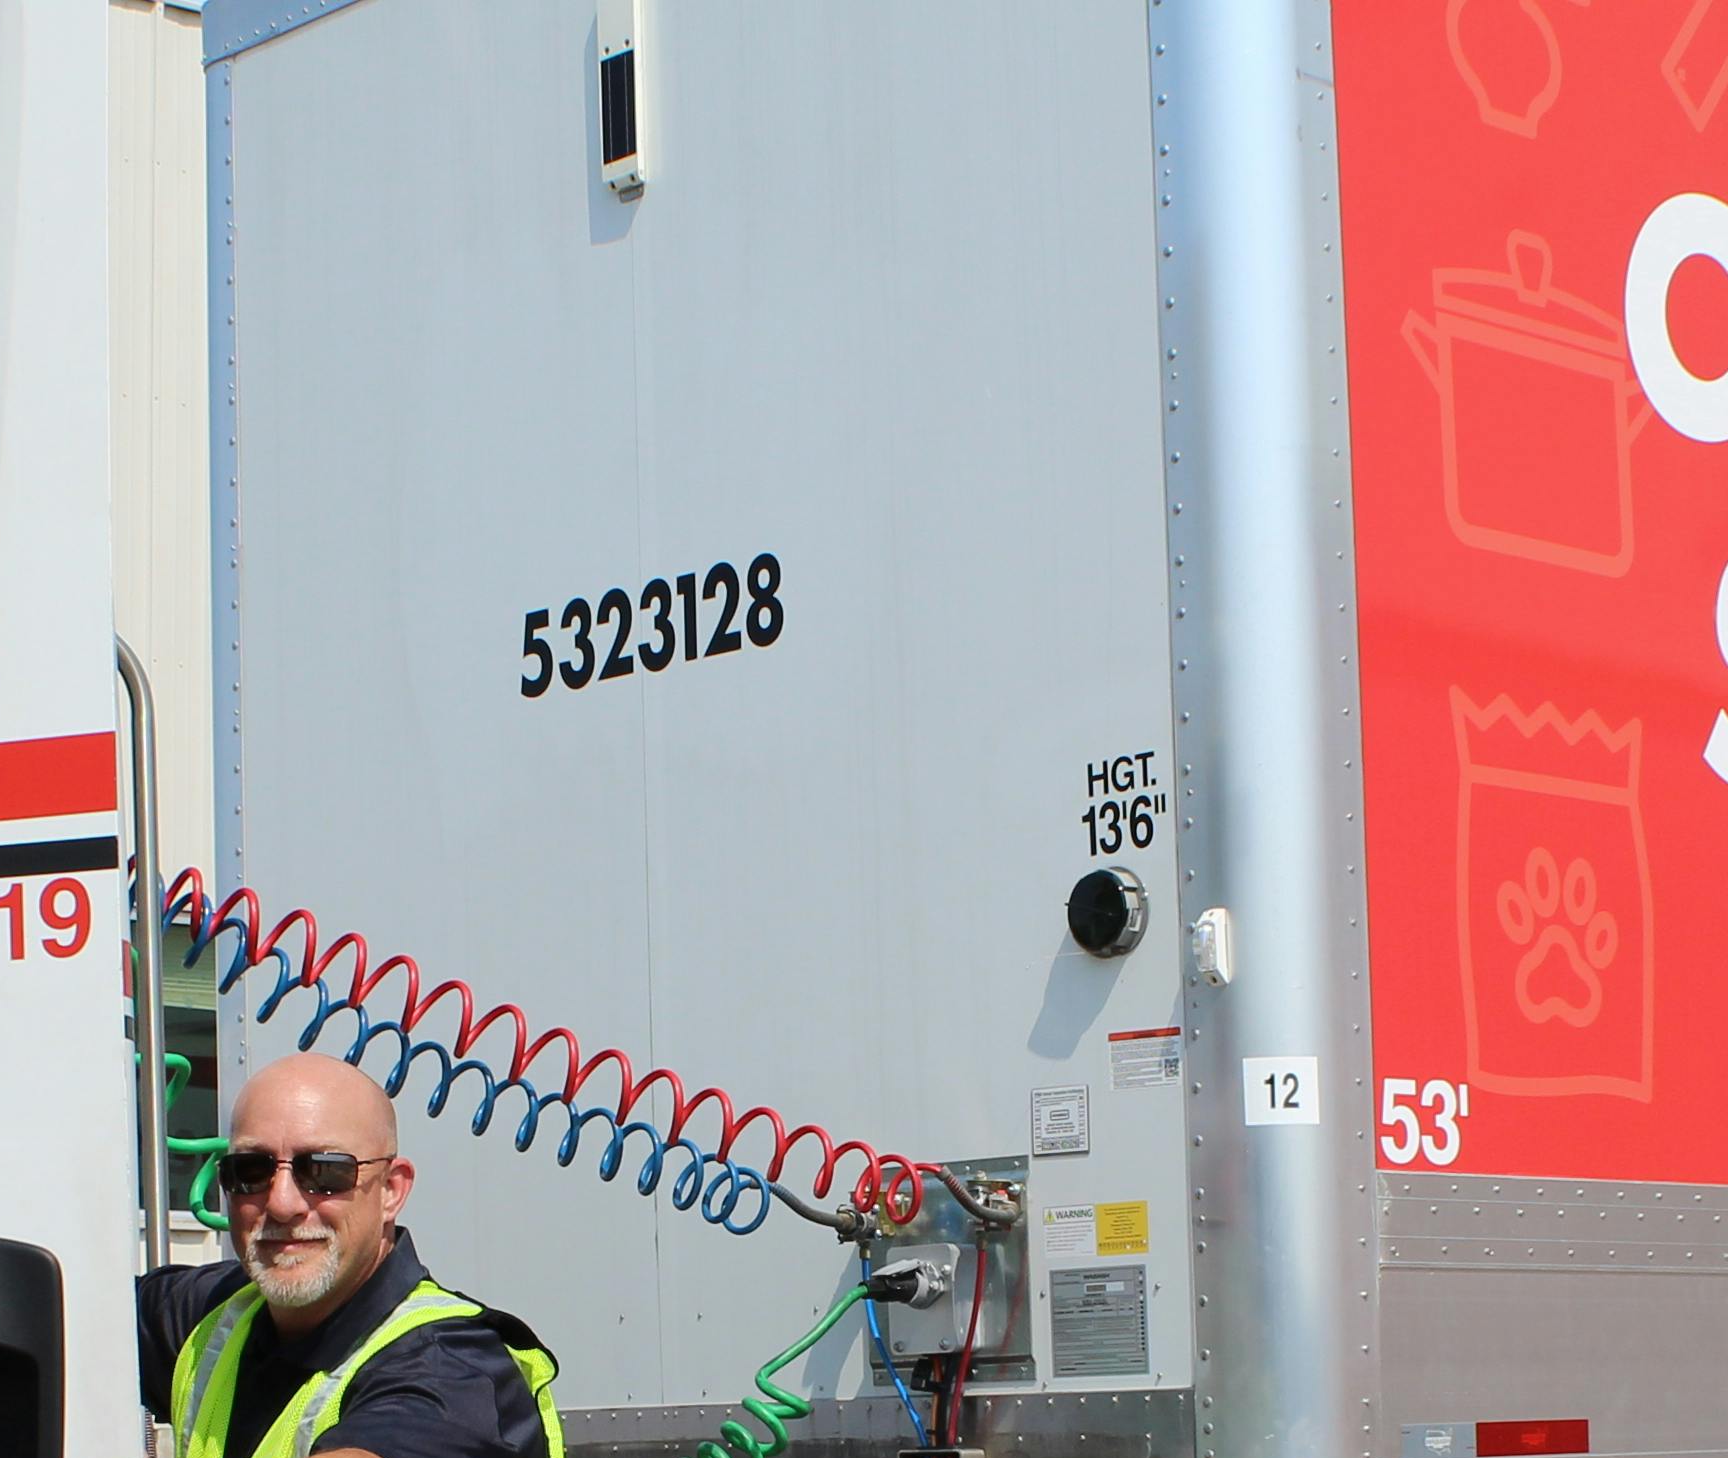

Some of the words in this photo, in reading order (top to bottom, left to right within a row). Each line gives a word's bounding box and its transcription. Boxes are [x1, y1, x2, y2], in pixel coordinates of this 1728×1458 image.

[520, 552, 784, 698] 5323128
[1087, 750, 1156, 798] HGT.
[1081, 794, 1167, 857] 13'6"
[1265, 1073, 1298, 1108] 12
[1380, 1077, 1469, 1166] 53'
[1055, 1208, 1094, 1220] WARNING
